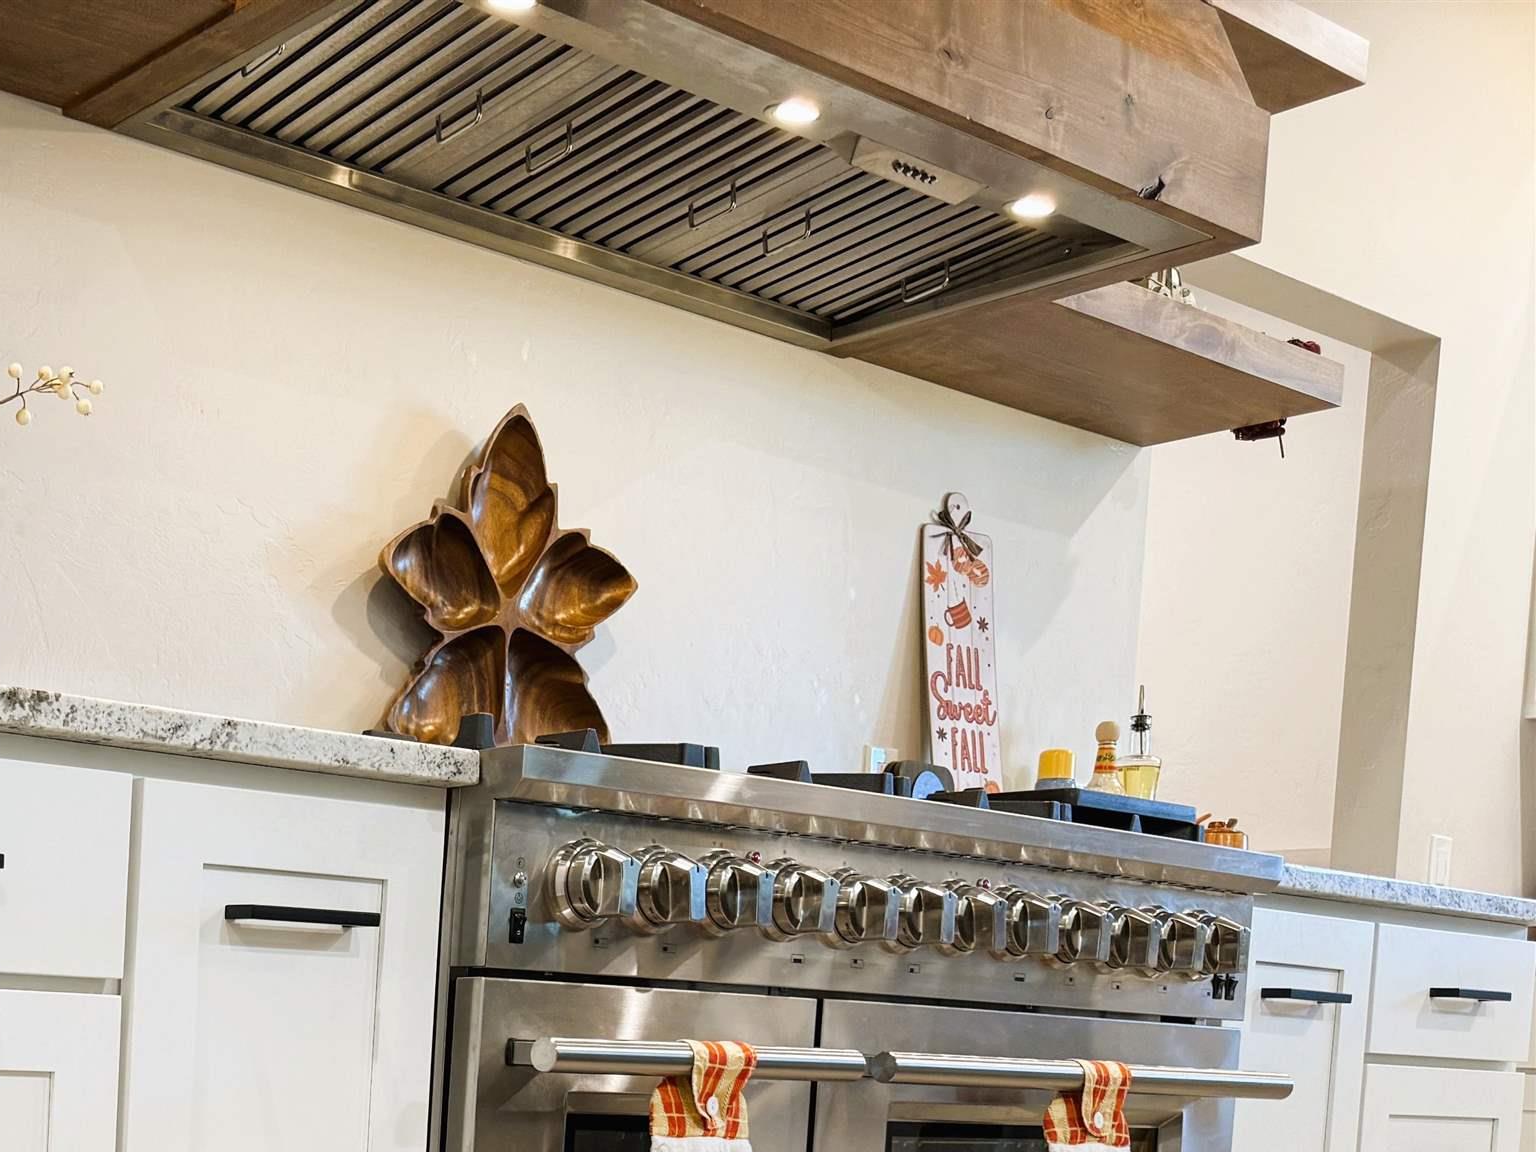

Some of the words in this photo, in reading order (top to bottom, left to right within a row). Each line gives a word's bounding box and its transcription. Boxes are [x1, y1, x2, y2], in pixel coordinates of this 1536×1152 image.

[946, 643, 983, 691] FALL
[930, 670, 997, 726] Sweet
[951, 727, 988, 774] FALL
